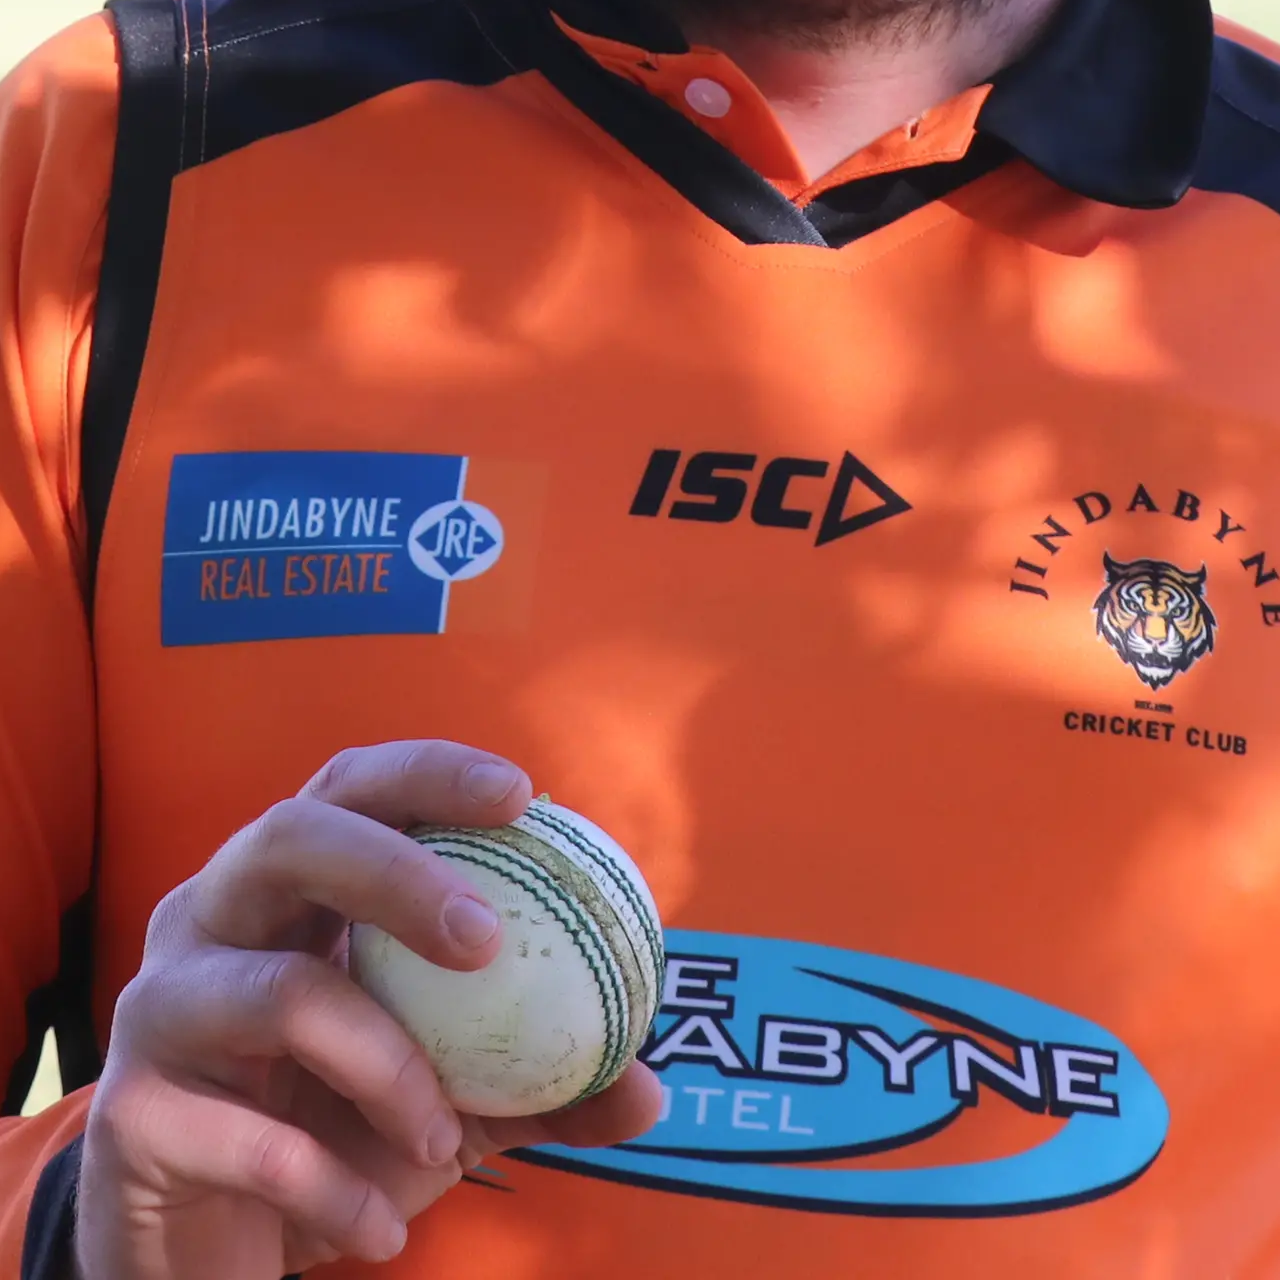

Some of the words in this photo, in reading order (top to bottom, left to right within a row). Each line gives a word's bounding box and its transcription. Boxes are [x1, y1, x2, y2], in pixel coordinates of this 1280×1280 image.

[200, 497, 401, 543] JINDABYNE
[430, 517, 485, 560] JRE
[200, 557, 270, 601] REAL
[283, 553, 393, 597] ESTATE
[1064, 711, 1175, 741] CRICKET
[1186, 727, 1247, 755] CLUB
[642, 1013, 1118, 1114] ABYNE
[658, 1084, 814, 1135] TEL
